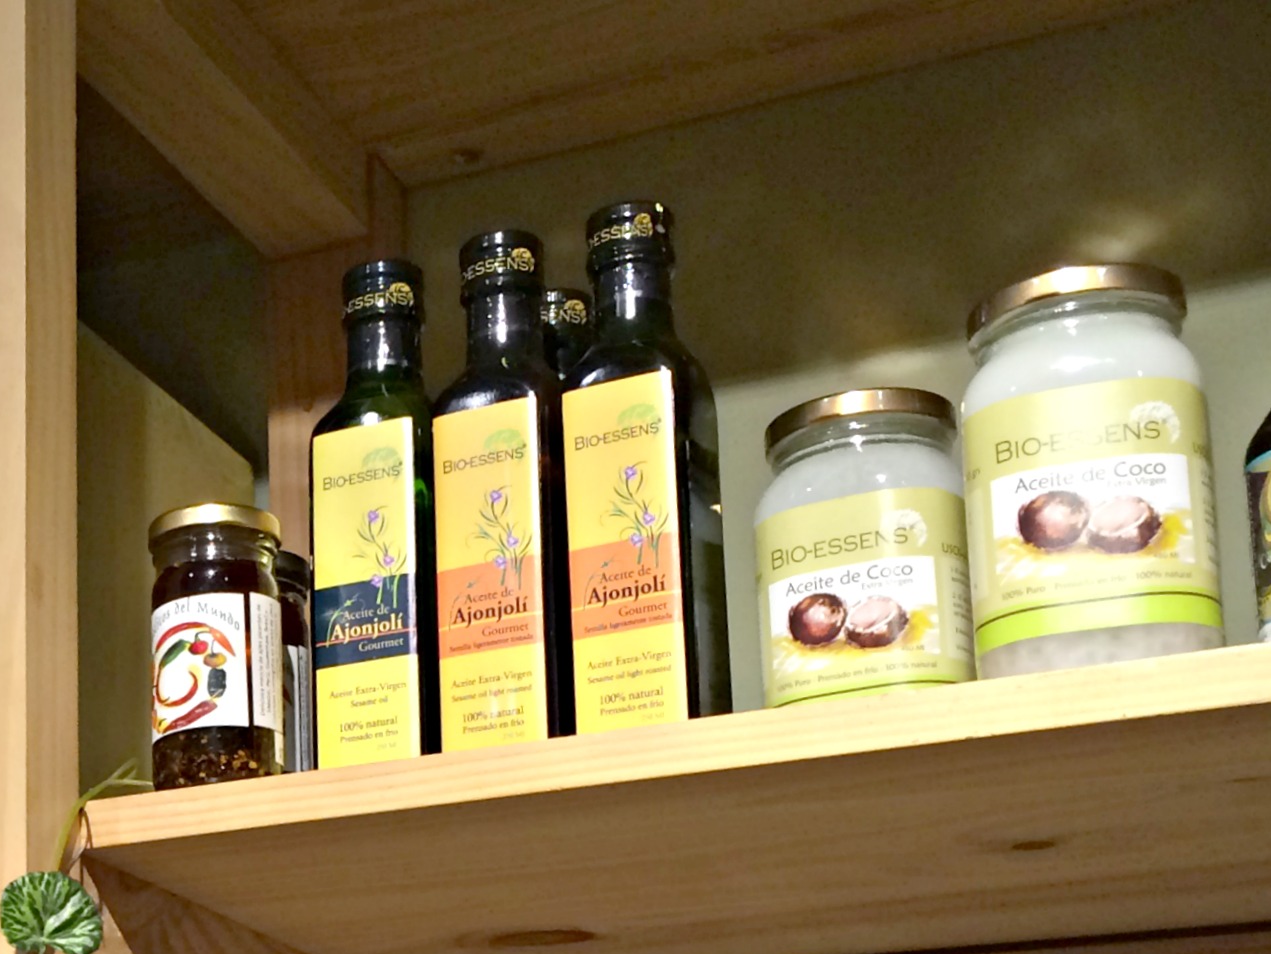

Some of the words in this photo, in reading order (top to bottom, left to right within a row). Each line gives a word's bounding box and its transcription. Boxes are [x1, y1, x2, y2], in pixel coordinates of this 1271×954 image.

[1015, 472, 1074, 494] Aceite
[1082, 469, 1105, 481] de
[1114, 461, 1166, 476] Coco
[600, 572, 635, 583] Aceite
[638, 565, 651, 576] de
[786, 576, 834, 597] Aceite
[841, 571, 860, 585] de
[867, 565, 912, 580] Coco
[465, 593, 498, 604] Aceite
[501, 587, 514, 599] de
[587, 574, 666, 607] Ajonjolí
[198, 602, 239, 630] Mundo
[342, 608, 374, 621] Aceite
[377, 605, 389, 615] de
[452, 597, 528, 627] Ajonjolí
[619, 602, 667, 617] Gourmet
[331, 612, 404, 644] Ajonjolí
[482, 623, 529, 637] Gourmet
[359, 638, 404, 651] Gourmet
[600, 692, 626, 705] 100%
[629, 687, 663, 700] natural
[638, 702, 648, 710] en
[339, 721, 363, 733] 100%
[366, 716, 398, 729] natural
[462, 711, 487, 723] 100%
